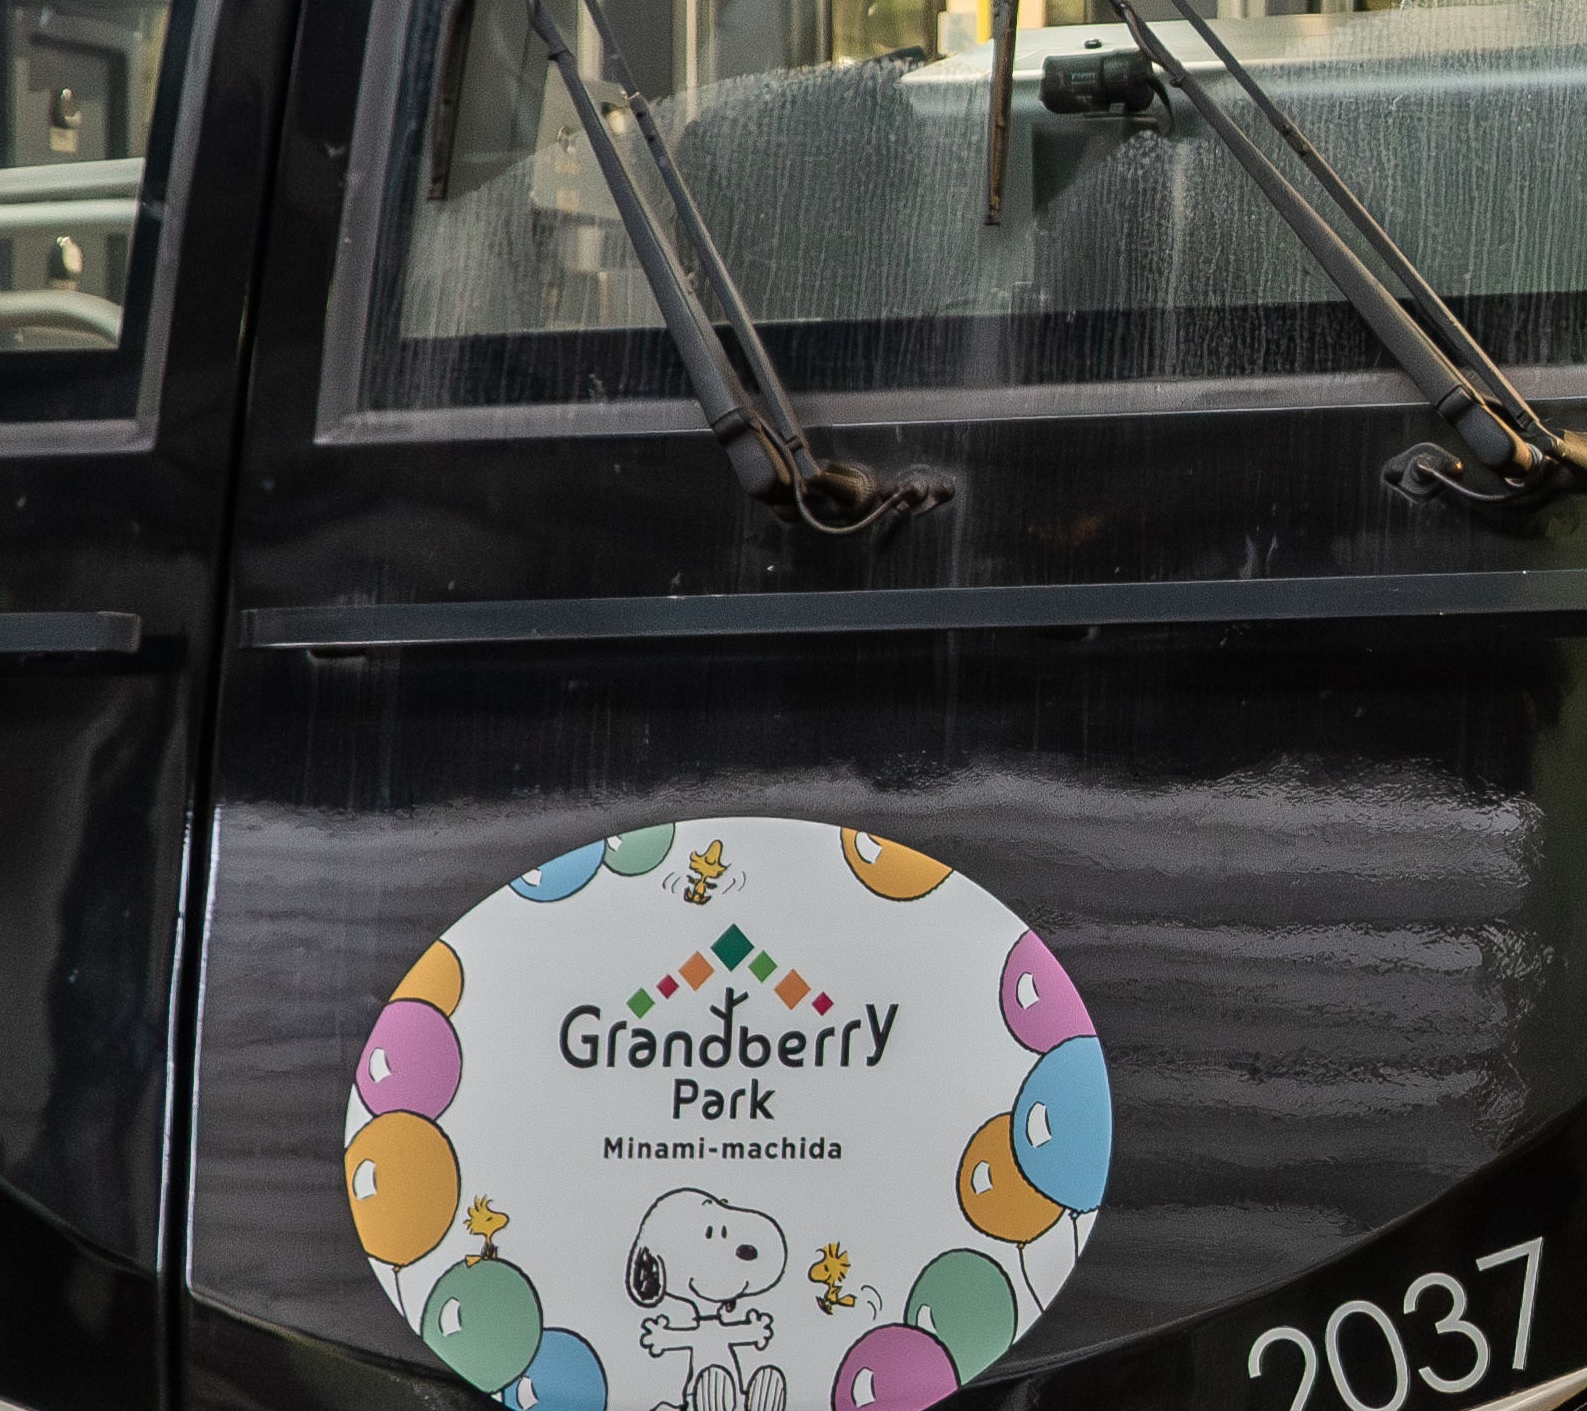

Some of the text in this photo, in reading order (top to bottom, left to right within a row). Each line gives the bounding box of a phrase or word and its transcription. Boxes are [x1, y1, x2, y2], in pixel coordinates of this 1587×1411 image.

[559, 987, 899, 1069] Grandberry
[672, 1078, 776, 1121] Park
[603, 1137, 843, 1160] Minami-machida
